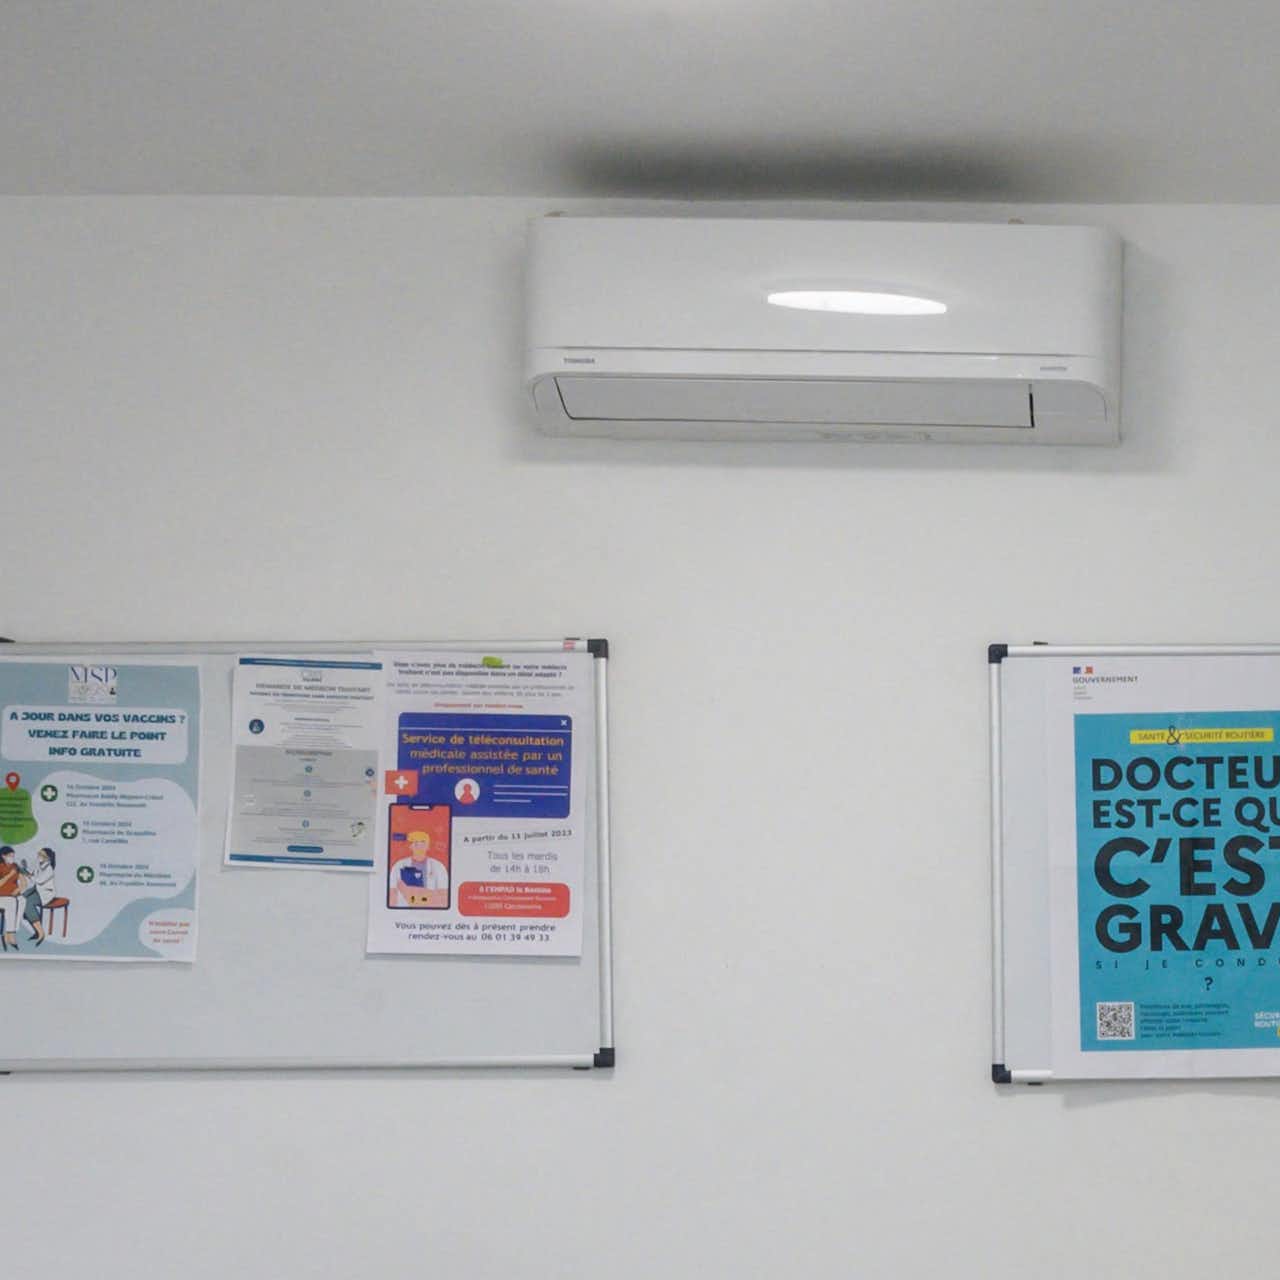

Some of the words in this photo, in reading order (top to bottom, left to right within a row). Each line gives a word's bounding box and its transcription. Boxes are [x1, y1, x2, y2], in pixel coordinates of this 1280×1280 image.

[1072, 676, 1138, 684] GOUVERNEMENT
[10, 712, 18, 720] A
[21, 712, 55, 721] JOUR
[58, 713, 91, 722] DANS
[95, 714, 119, 722] VOS
[123, 714, 176, 724] VACCINS
[28, 730, 69, 738] VENEZ
[72, 730, 108, 739] FAIRE
[110, 731, 127, 740] LE
[130, 732, 167, 741] POINT
[402, 733, 446, 744] Service
[450, 734, 465, 745] de
[1167, 725, 1181, 745] &
[48, 747, 77, 756] INFO
[80, 747, 142, 757] GRATUITE
[410, 749, 466, 760] médicale
[470, 750, 518, 761] assistée
[522, 753, 542, 762] par
[422, 763, 504, 775] professionnel
[507, 764, 522, 775] de
[525, 764, 559, 776] santé
[1093, 797, 1222, 829] EST-CE
[472, 834, 496, 844] partir
[488, 850, 509, 860] Tous
[511, 851, 525, 861] les
[489, 864, 501, 873] de
[394, 922, 416, 930] Vous
[419, 922, 452, 931] pouvez
[482, 922, 516, 933] présent
[519, 922, 556, 933] prendre
[408, 933, 464, 942] rendez-vous
[466, 934, 478, 942] au
[481, 933, 493, 942] 06
[1096, 959, 1119, 970] SI
[1145, 959, 1168, 970] JE
[1204, 977, 1214, 992] ?
